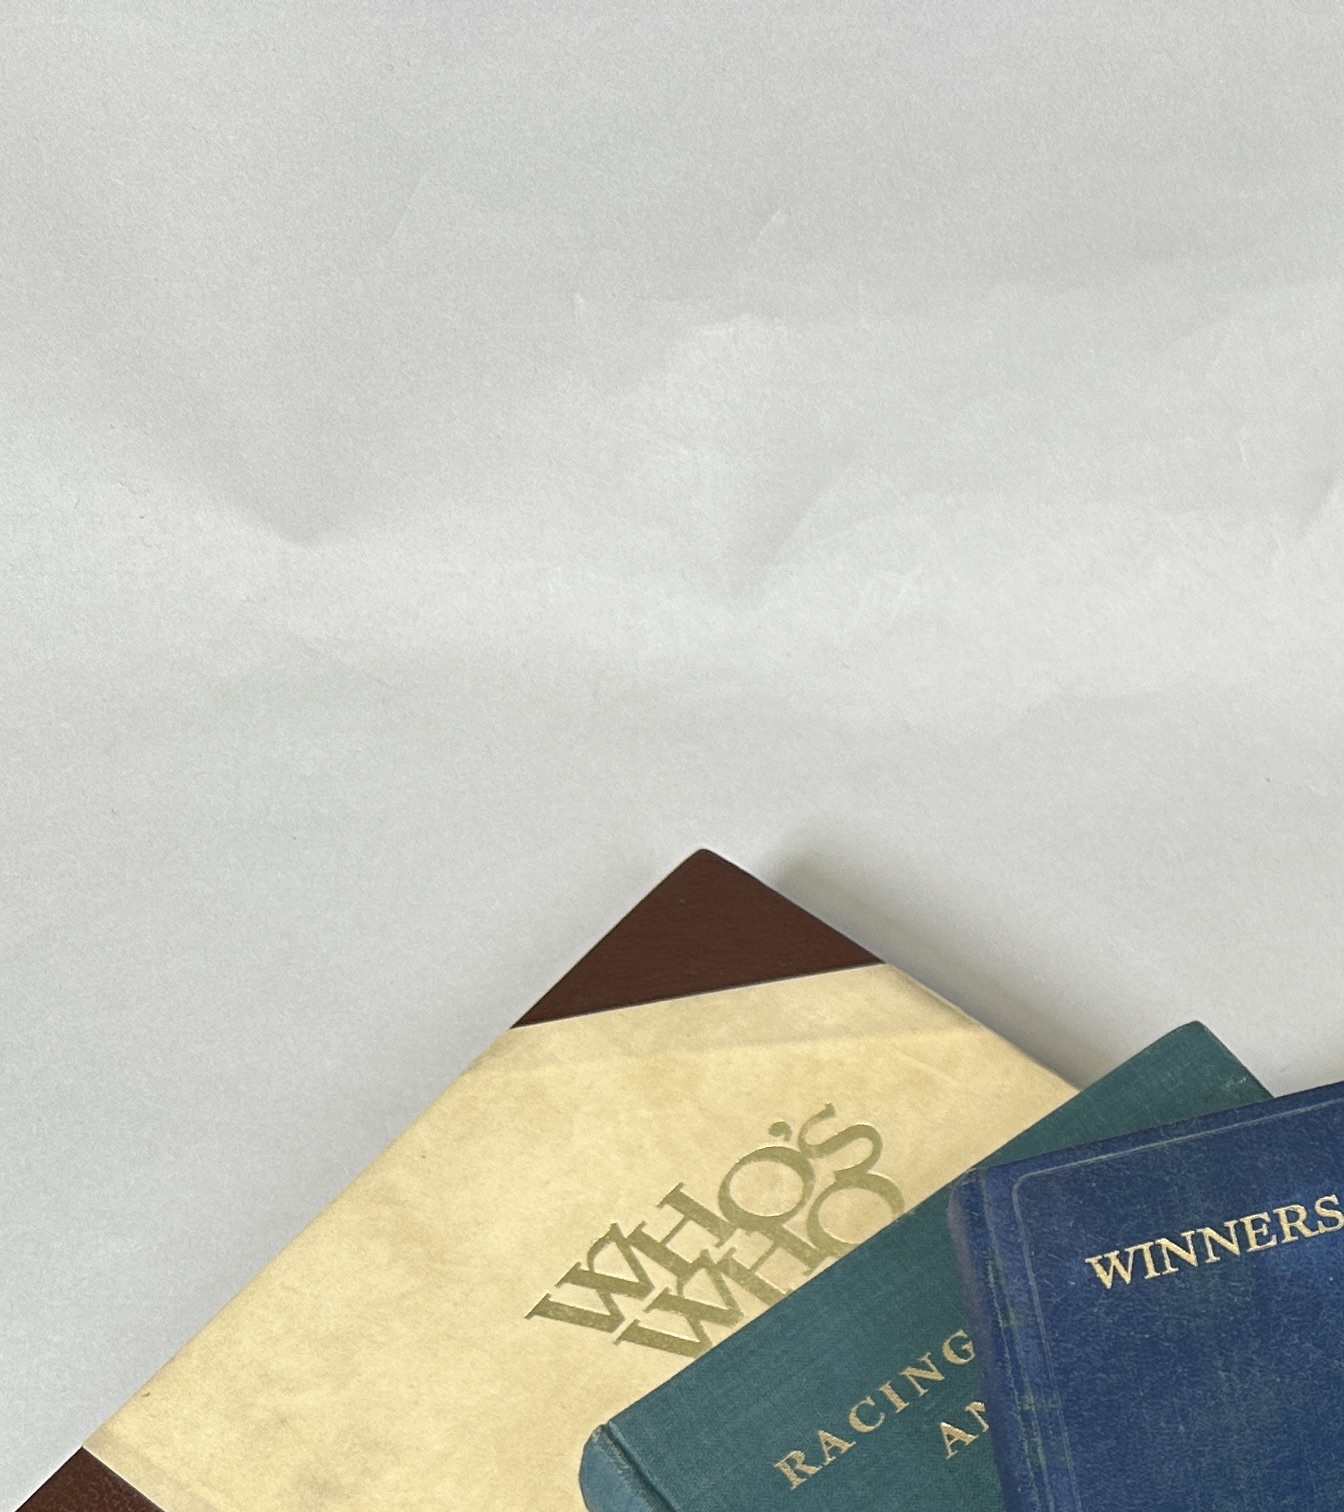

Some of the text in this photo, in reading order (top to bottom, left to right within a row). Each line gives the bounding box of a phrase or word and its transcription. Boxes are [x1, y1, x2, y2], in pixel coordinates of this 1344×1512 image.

[524, 1103, 884, 1335] WHO'S
[612, 1172, 905, 1359] WHO
[773, 1328, 976, 1491] RACING
